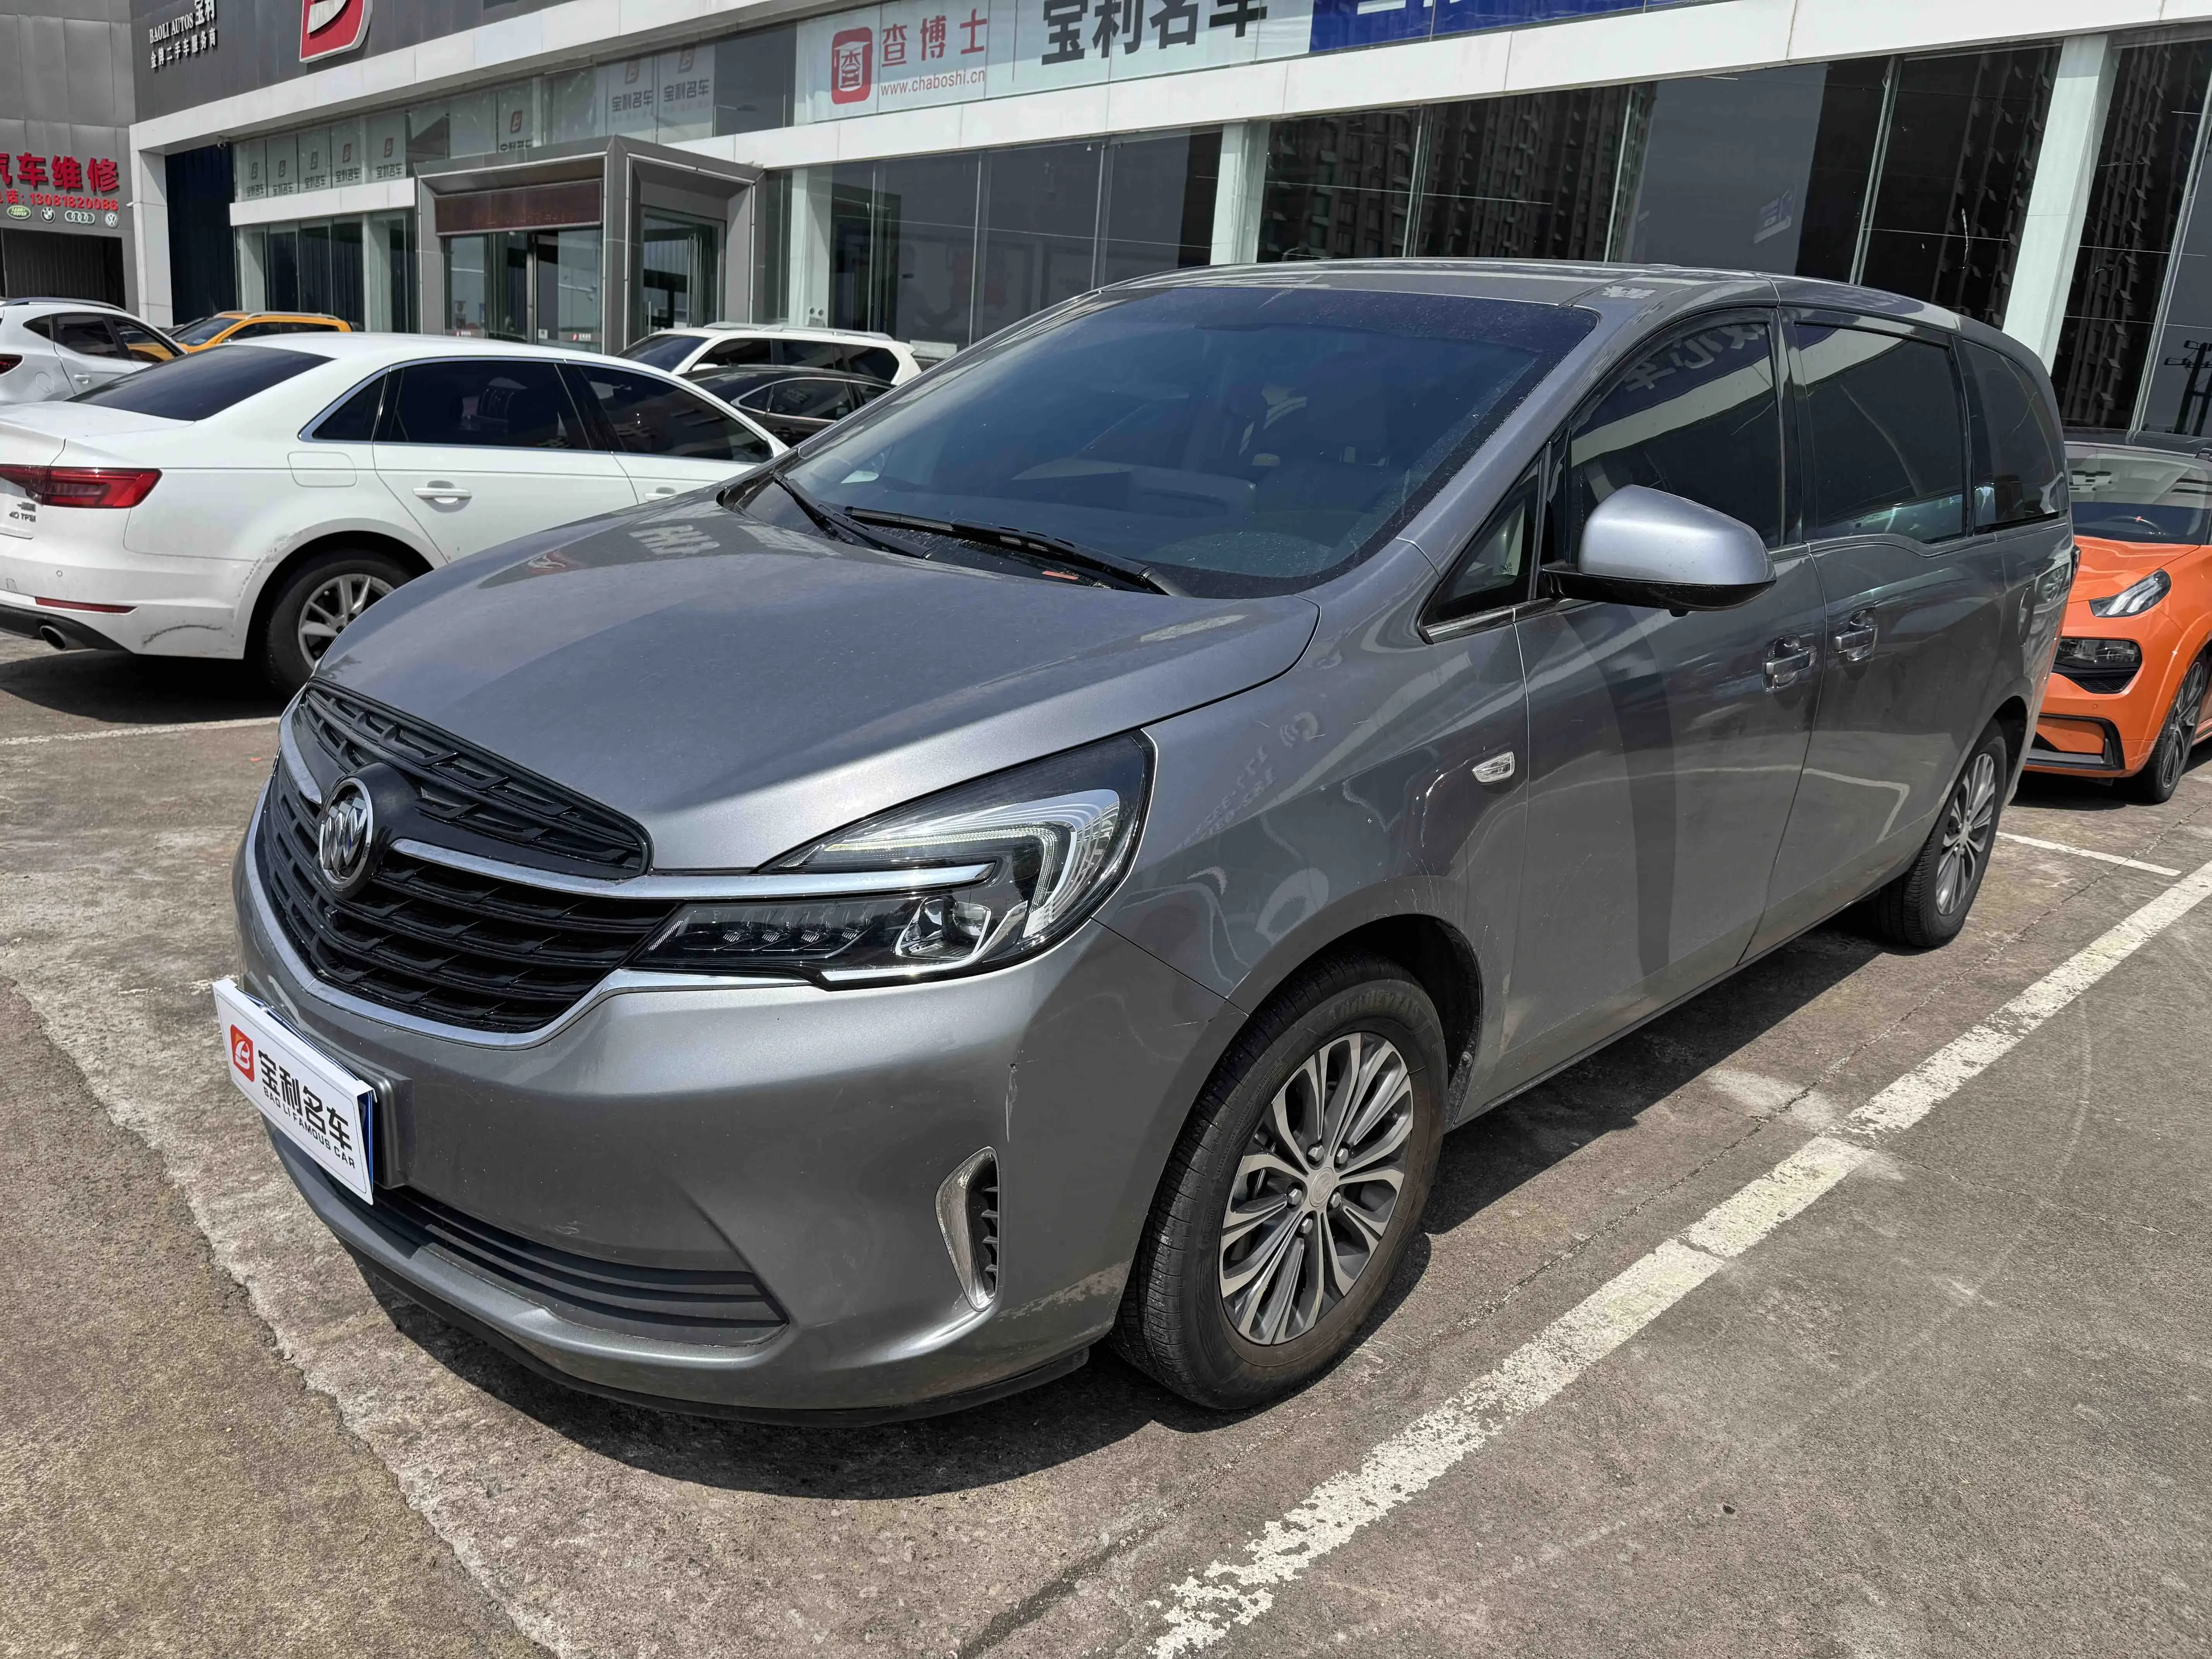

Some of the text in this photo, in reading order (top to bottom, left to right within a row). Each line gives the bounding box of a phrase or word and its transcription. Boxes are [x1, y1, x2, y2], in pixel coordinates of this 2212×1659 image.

[149, 12, 193, 43] BAOLI AUTOS
[664, 79, 709, 102] 宝利名车
[881, 69, 985, 96] www.chaboshi.cn
[258, 1049, 352, 1151] 宝利名车
[264, 1086, 355, 1169] BAO LI FAMOUS CAR
